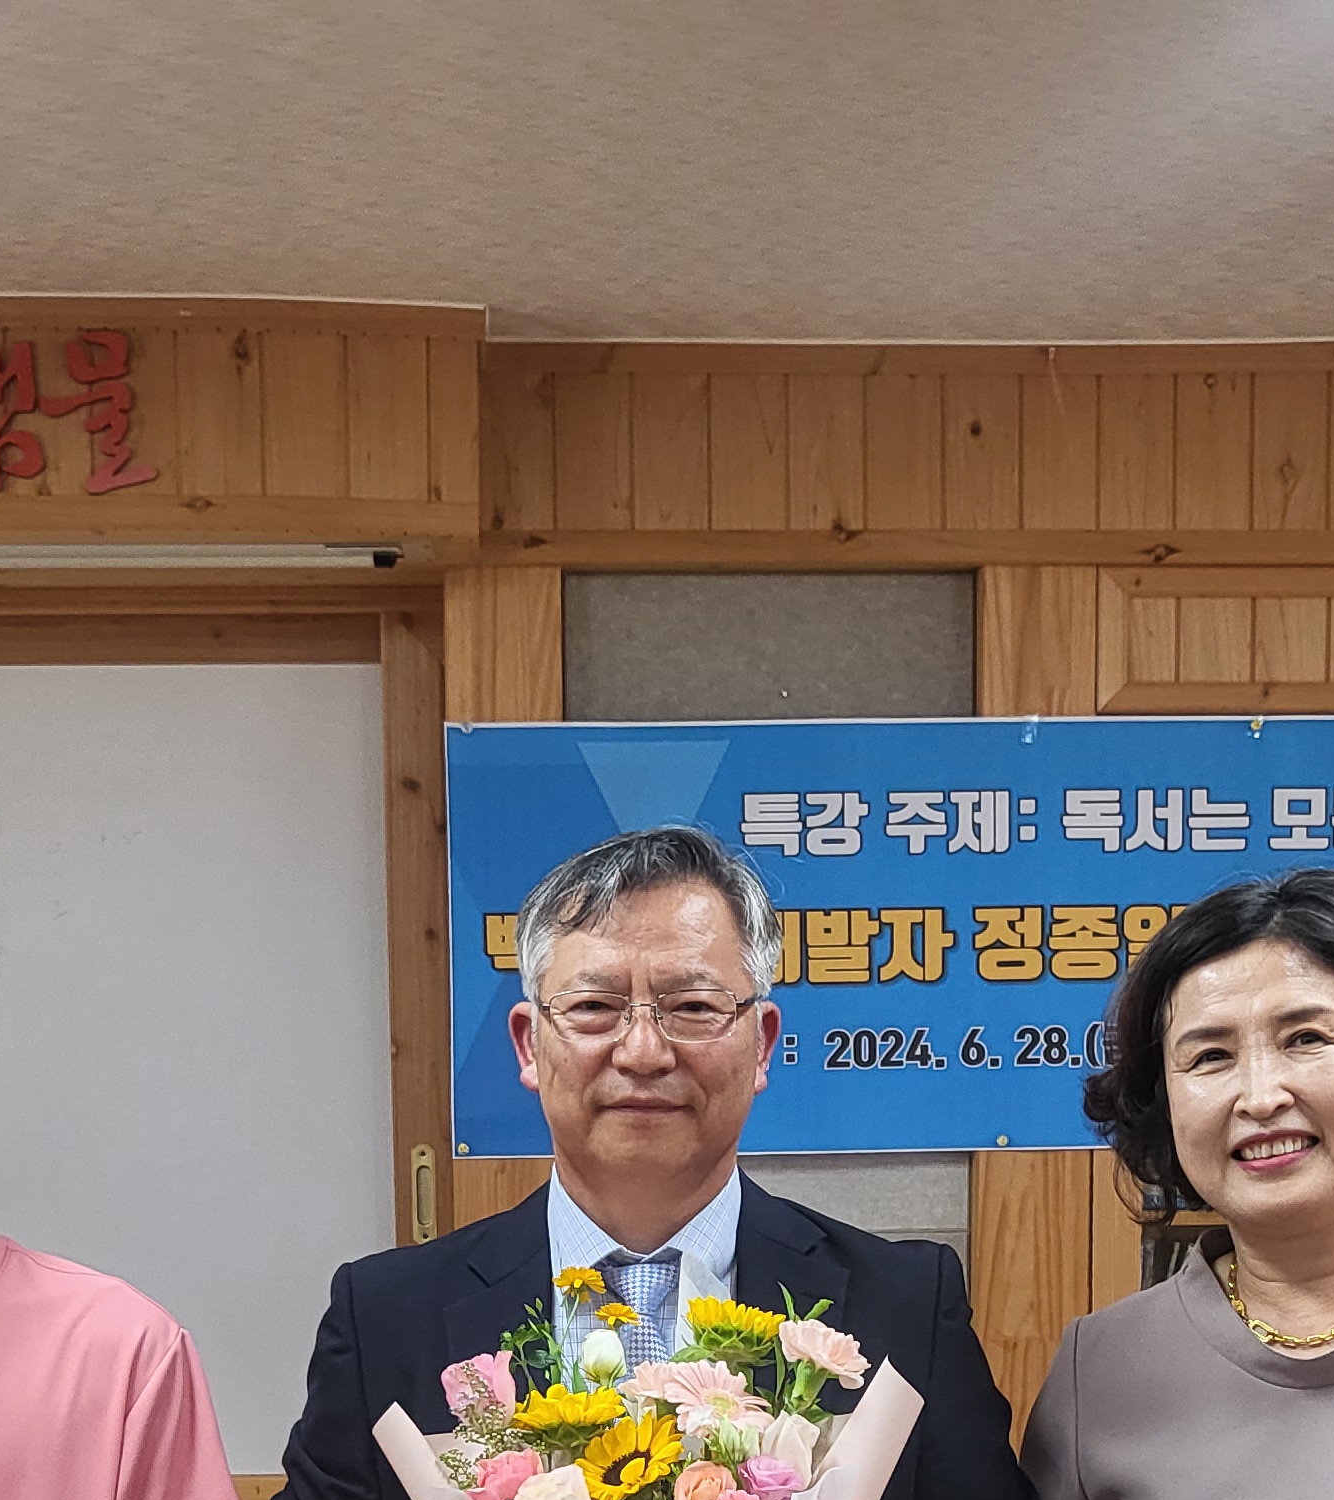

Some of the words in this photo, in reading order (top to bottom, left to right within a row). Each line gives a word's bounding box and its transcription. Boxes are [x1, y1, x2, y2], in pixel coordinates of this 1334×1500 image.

[740, 790, 871, 856] 특강
[884, 789, 1038, 856] 주제:
[1060, 787, 1252, 854] 독서는
[824, 1028, 946, 1070] 2024.
[960, 1027, 1001, 1068] 6.
